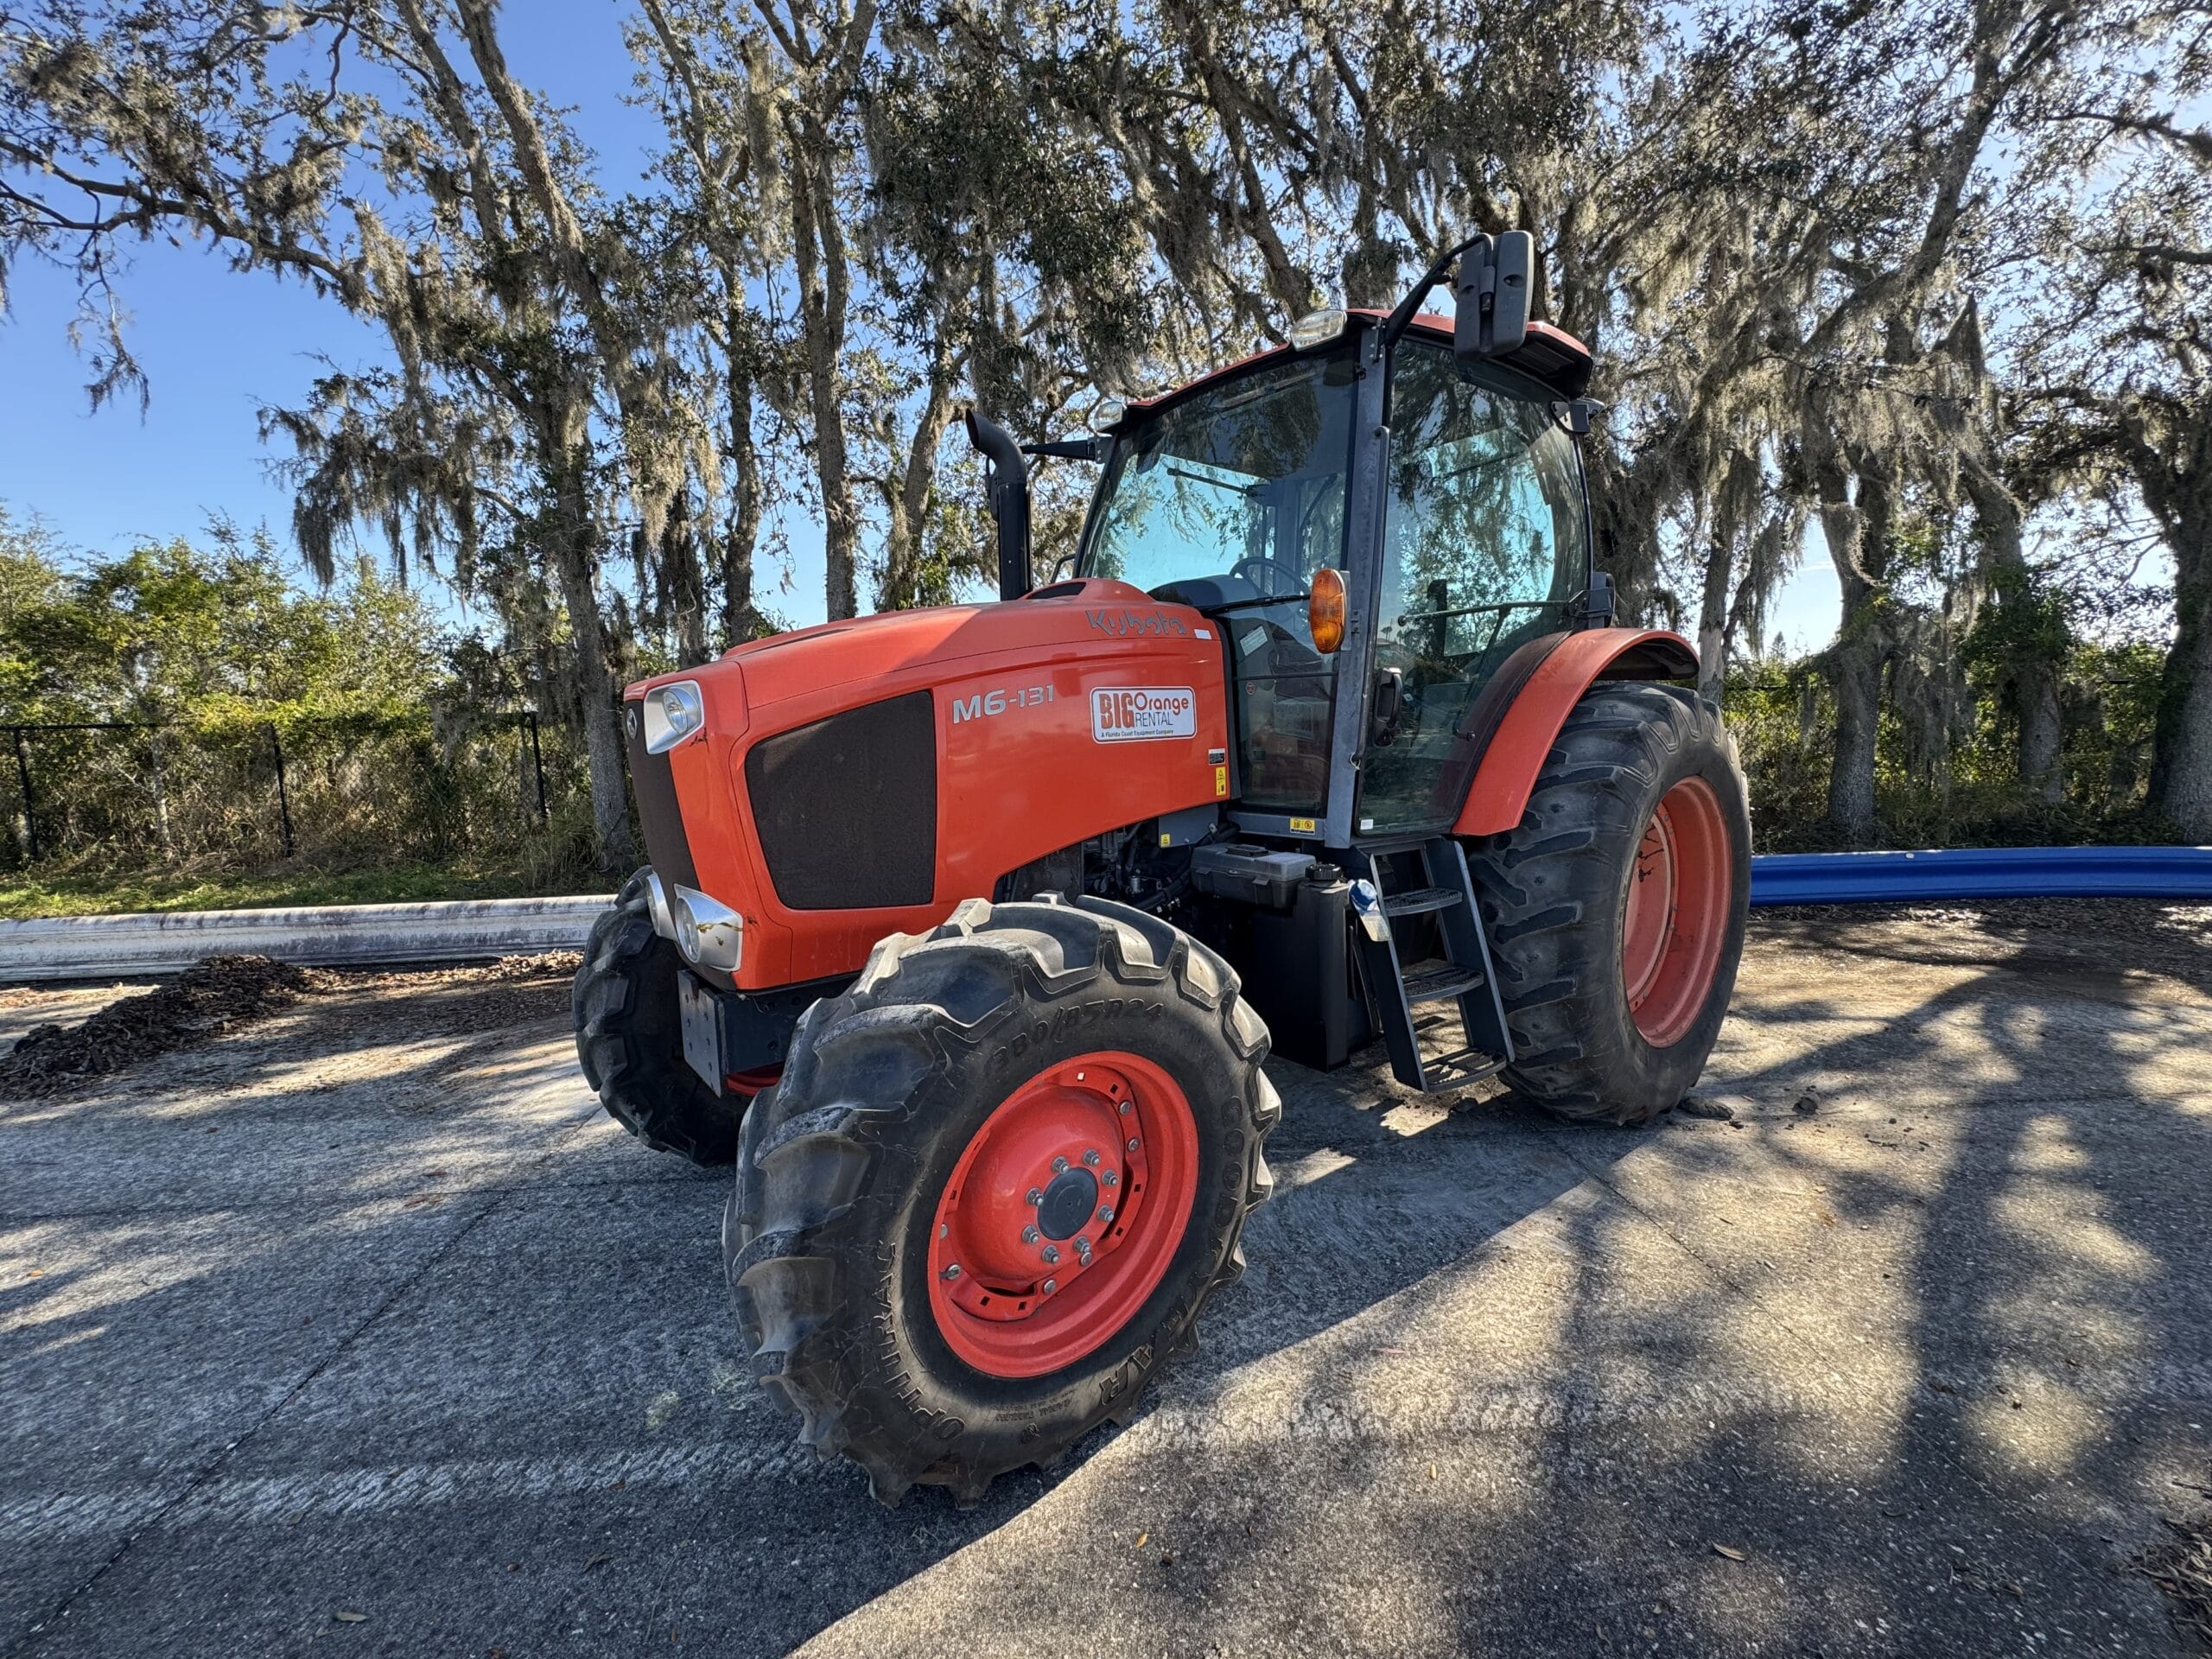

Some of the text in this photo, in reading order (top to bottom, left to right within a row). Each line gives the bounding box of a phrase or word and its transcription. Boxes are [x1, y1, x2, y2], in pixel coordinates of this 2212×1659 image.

[1084, 609, 1187, 636] Kubota
[952, 683, 1054, 724] M6-131
[1098, 691, 1190, 729] BIG Orange
[1135, 711, 1173, 727] RENTAL
